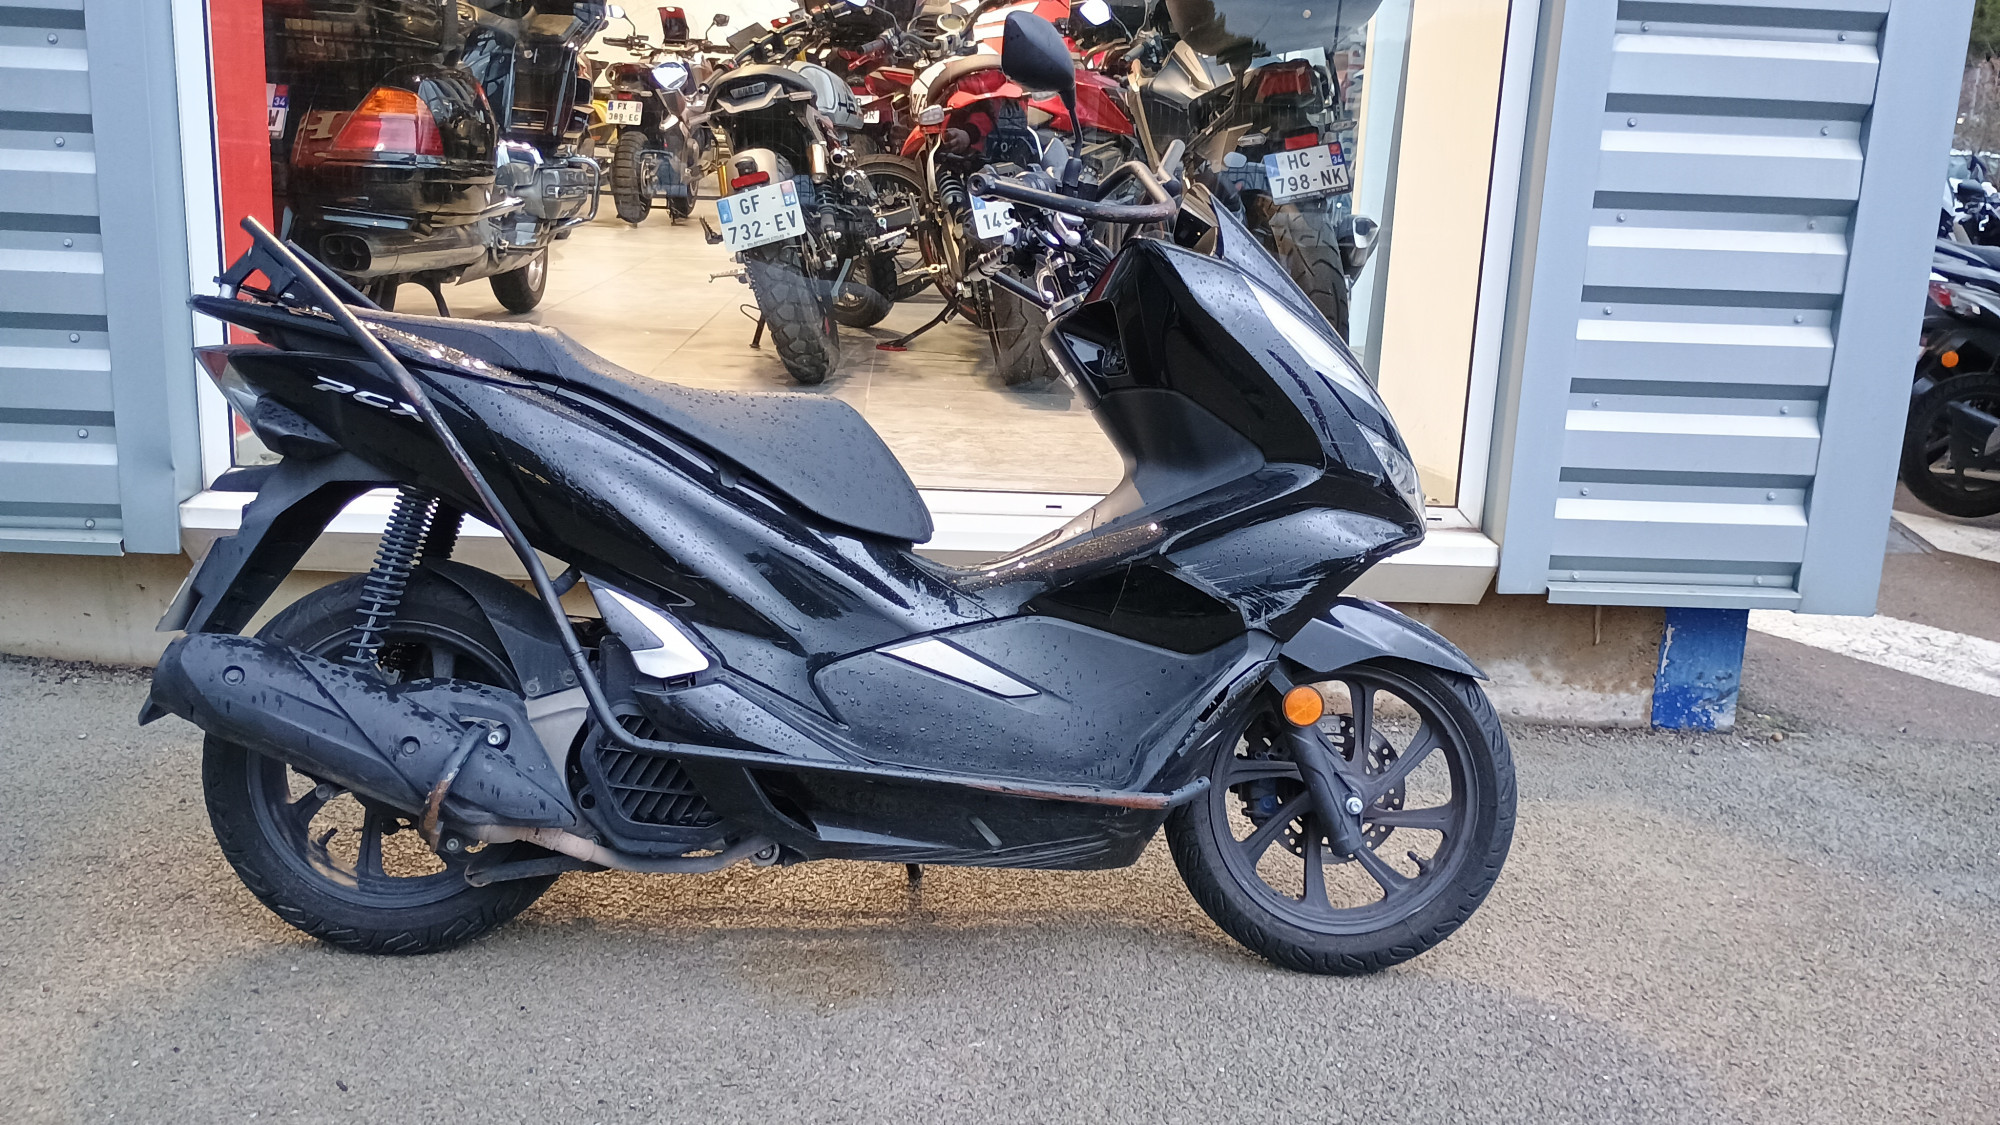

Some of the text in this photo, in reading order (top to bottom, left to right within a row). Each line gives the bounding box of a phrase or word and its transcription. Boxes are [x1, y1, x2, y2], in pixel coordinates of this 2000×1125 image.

[274, 97, 286, 106] 34
[1287, 152, 1311, 171] HC
[1331, 155, 1343, 165] 34
[739, 194, 760, 216] GF
